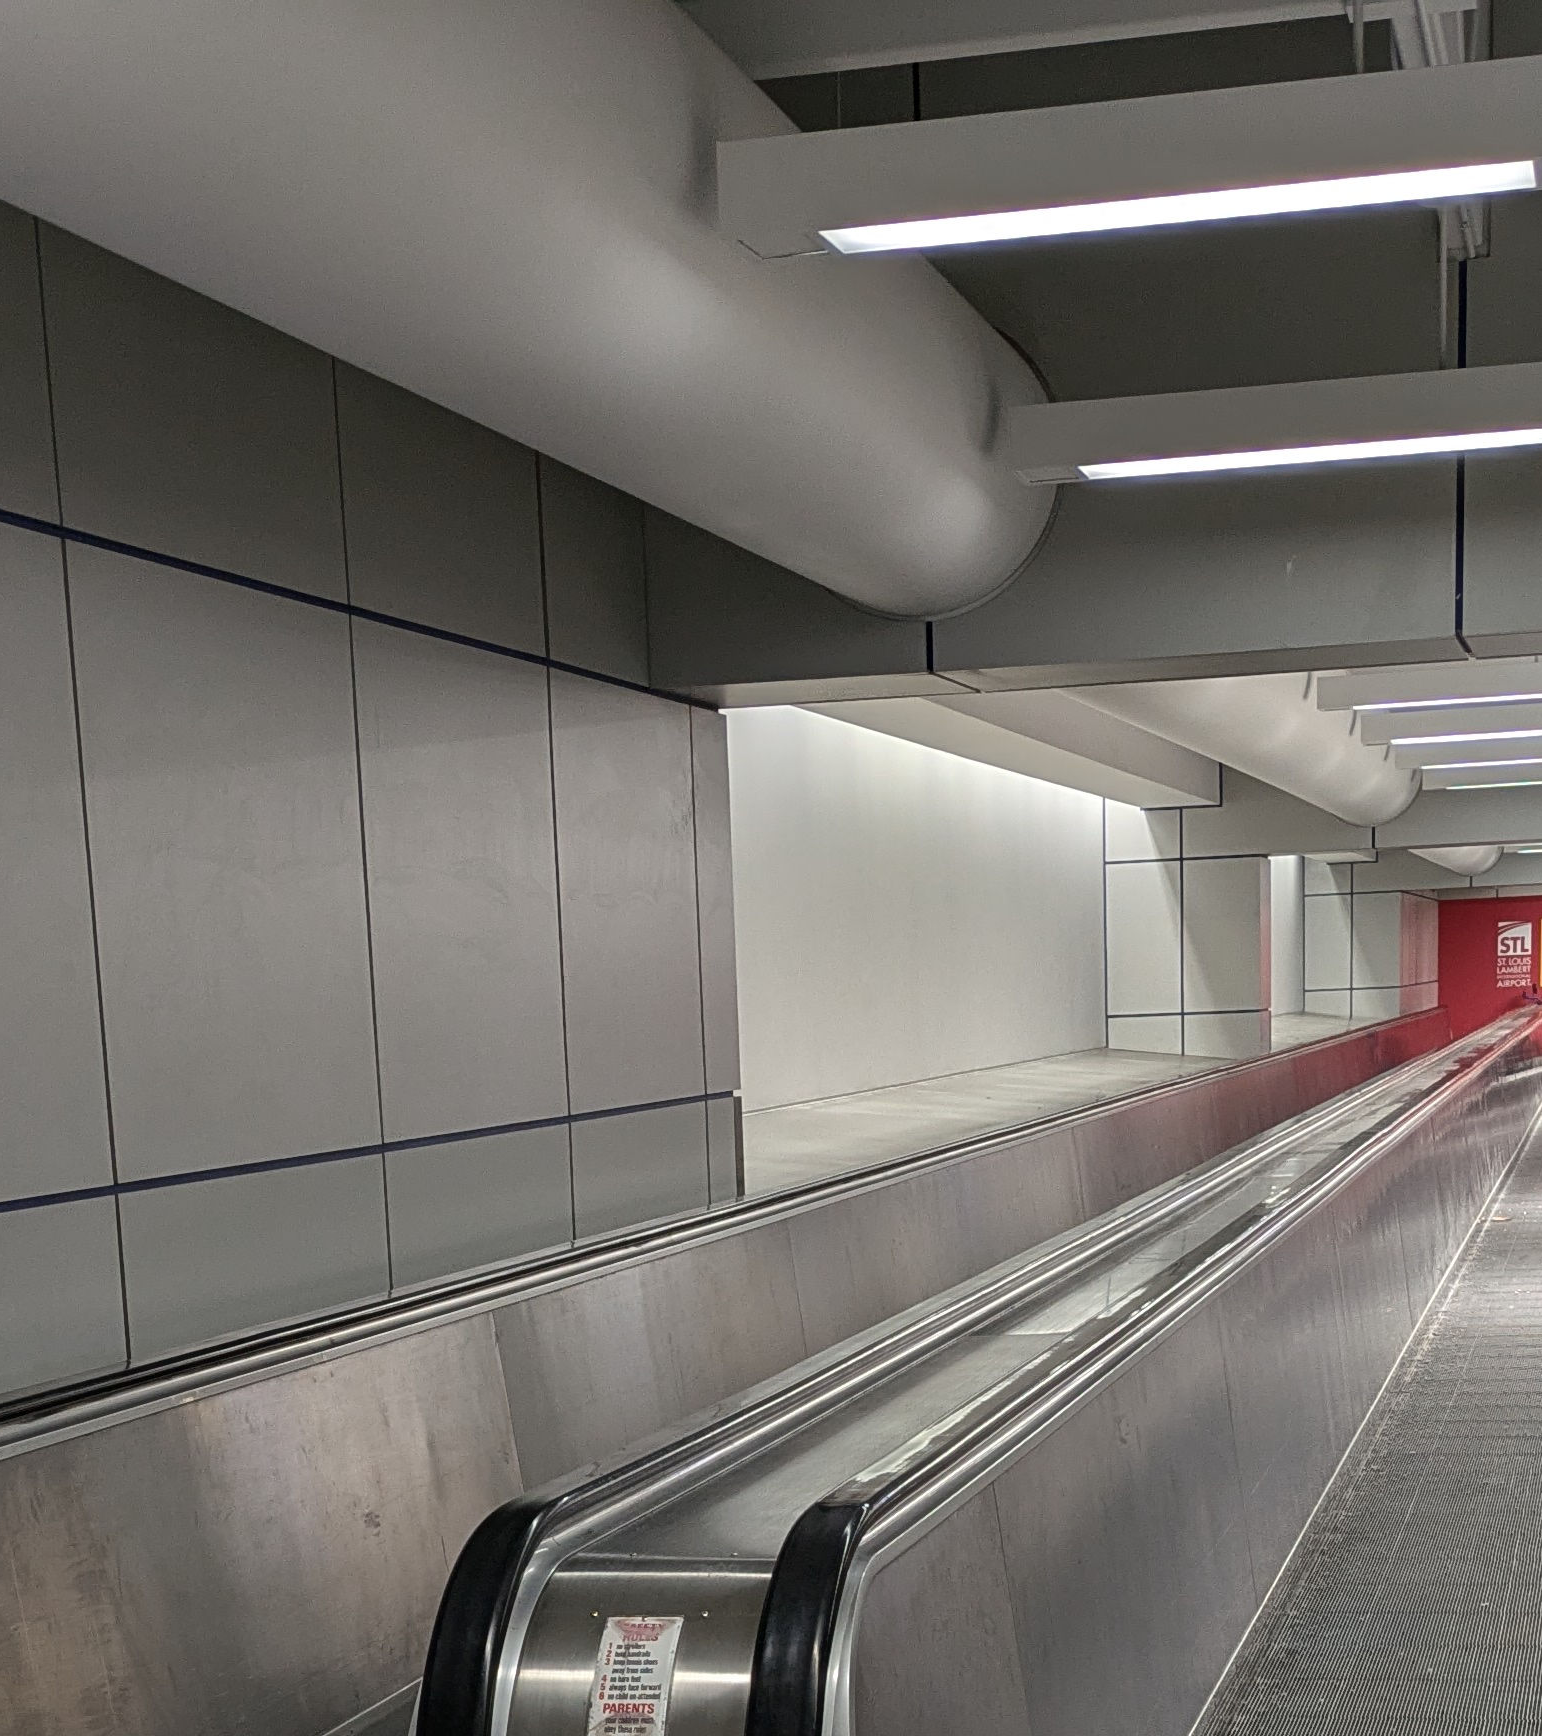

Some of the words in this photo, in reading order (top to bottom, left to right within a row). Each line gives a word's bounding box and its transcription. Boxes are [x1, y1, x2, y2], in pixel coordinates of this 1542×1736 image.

[1500, 936, 1529, 953] STL
[1508, 957, 1532, 965] LOUIS
[1497, 966, 1531, 974] LAMBERT
[599, 1692, 605, 1700] 6
[602, 1703, 655, 1714] PARENTS
